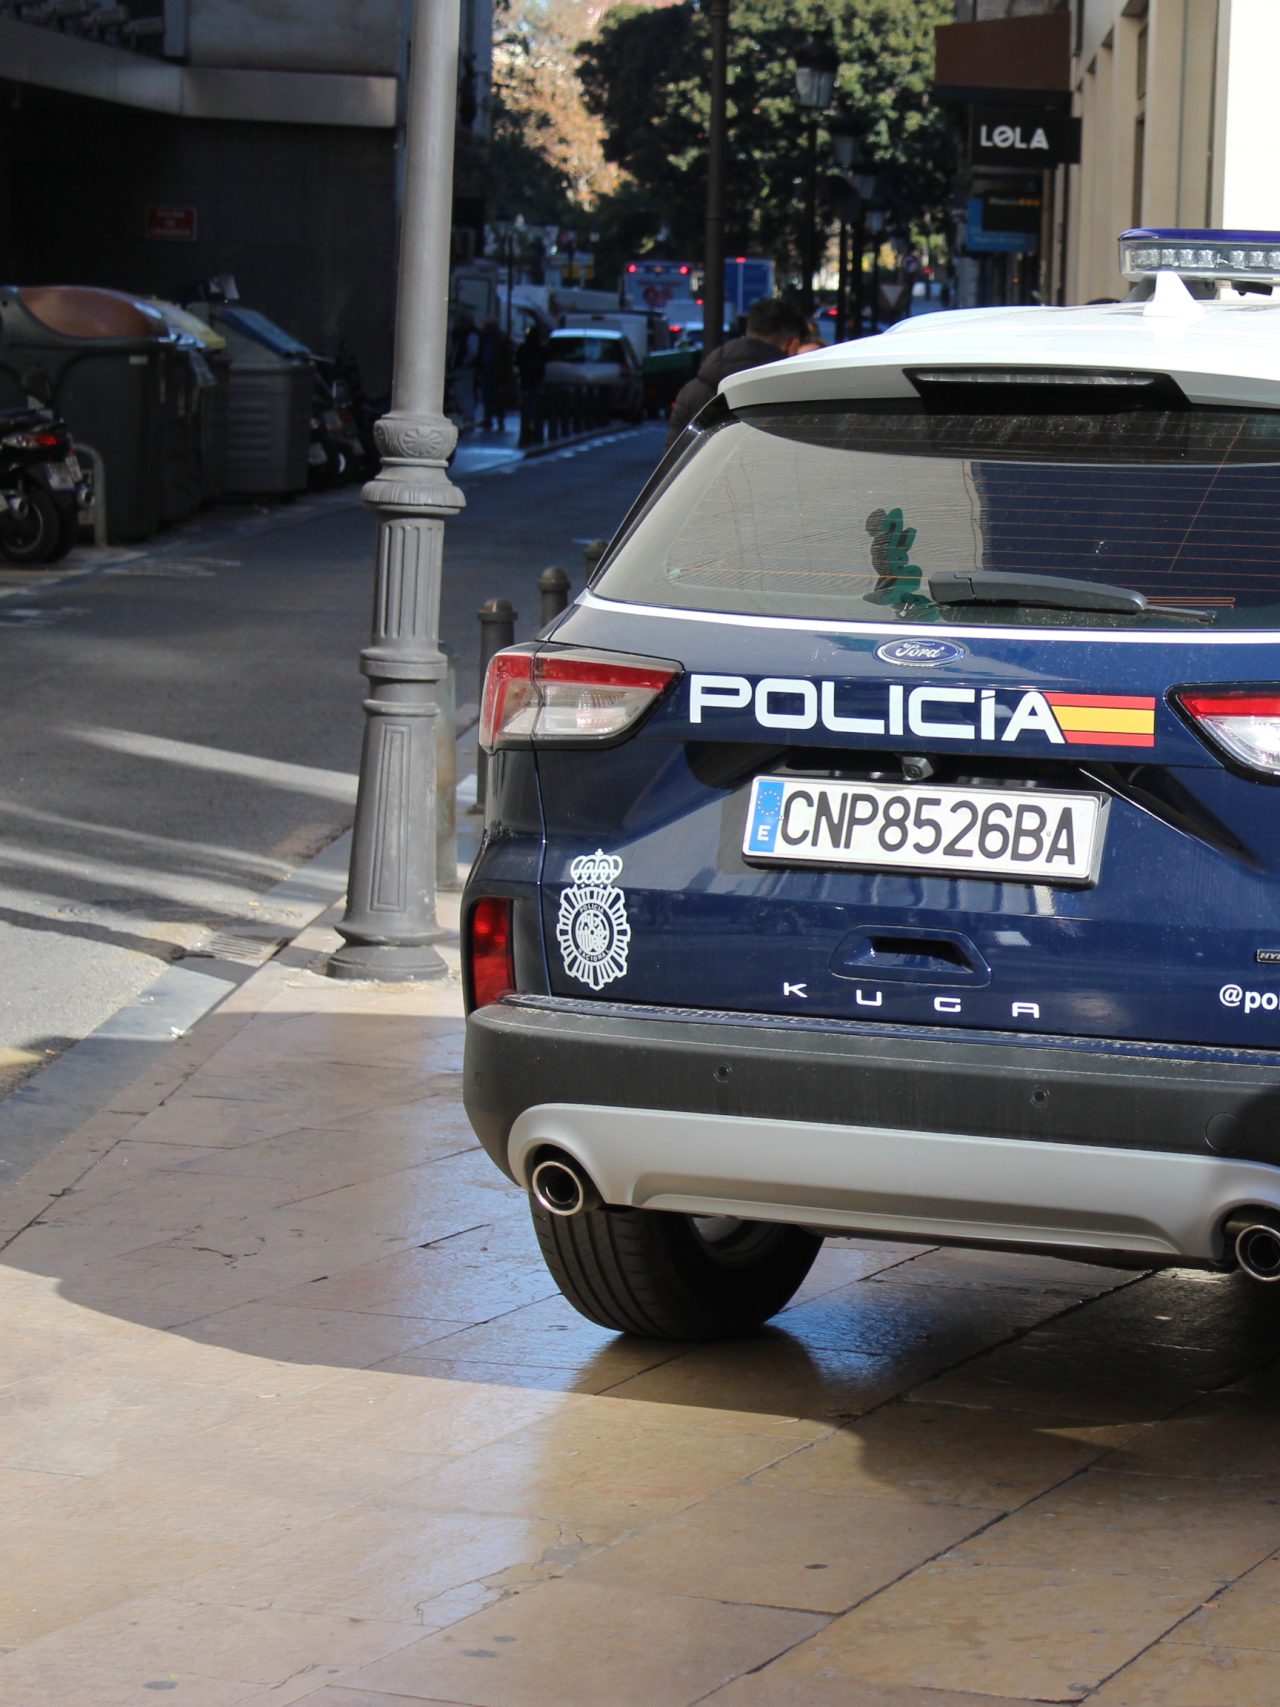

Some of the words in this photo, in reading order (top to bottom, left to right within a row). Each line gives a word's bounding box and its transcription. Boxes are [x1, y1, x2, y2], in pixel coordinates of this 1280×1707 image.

[896, 641, 945, 658] Ford
[758, 825, 771, 841] E
[780, 790, 1075, 865] CNP8526BA
[783, 982, 1040, 1019] KUGA
